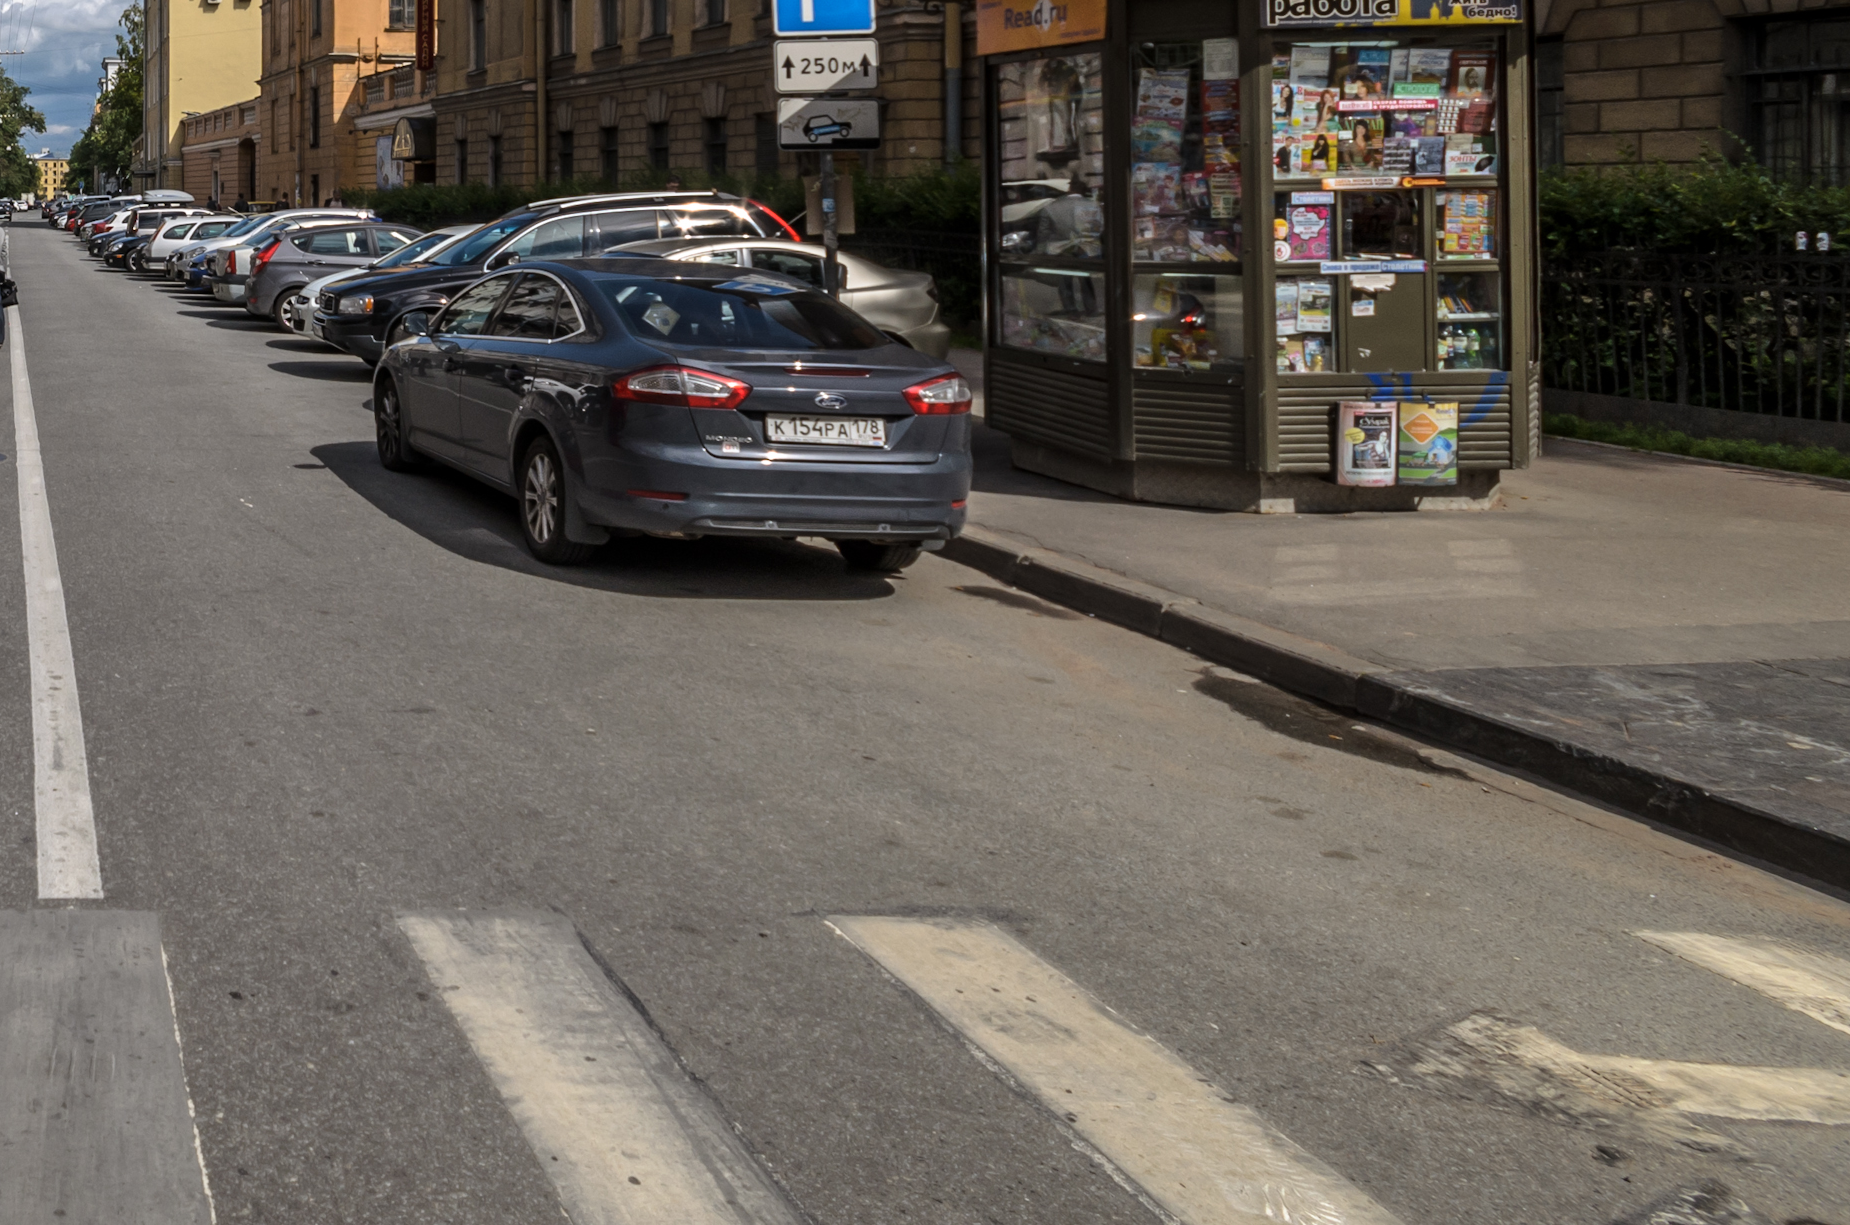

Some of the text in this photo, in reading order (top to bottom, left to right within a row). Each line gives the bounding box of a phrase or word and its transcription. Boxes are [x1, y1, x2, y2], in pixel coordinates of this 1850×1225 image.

[1003, 1, 1068, 30] Read.ru
[1467, 5, 1517, 18] бедно!
[1396, 84, 1437, 93] АСТРОЛОГИЯ
[1449, 155, 1477, 163] ЗОНТЫ
[1322, 263, 1342, 272] Снова
[852, 418, 880, 435] 178
